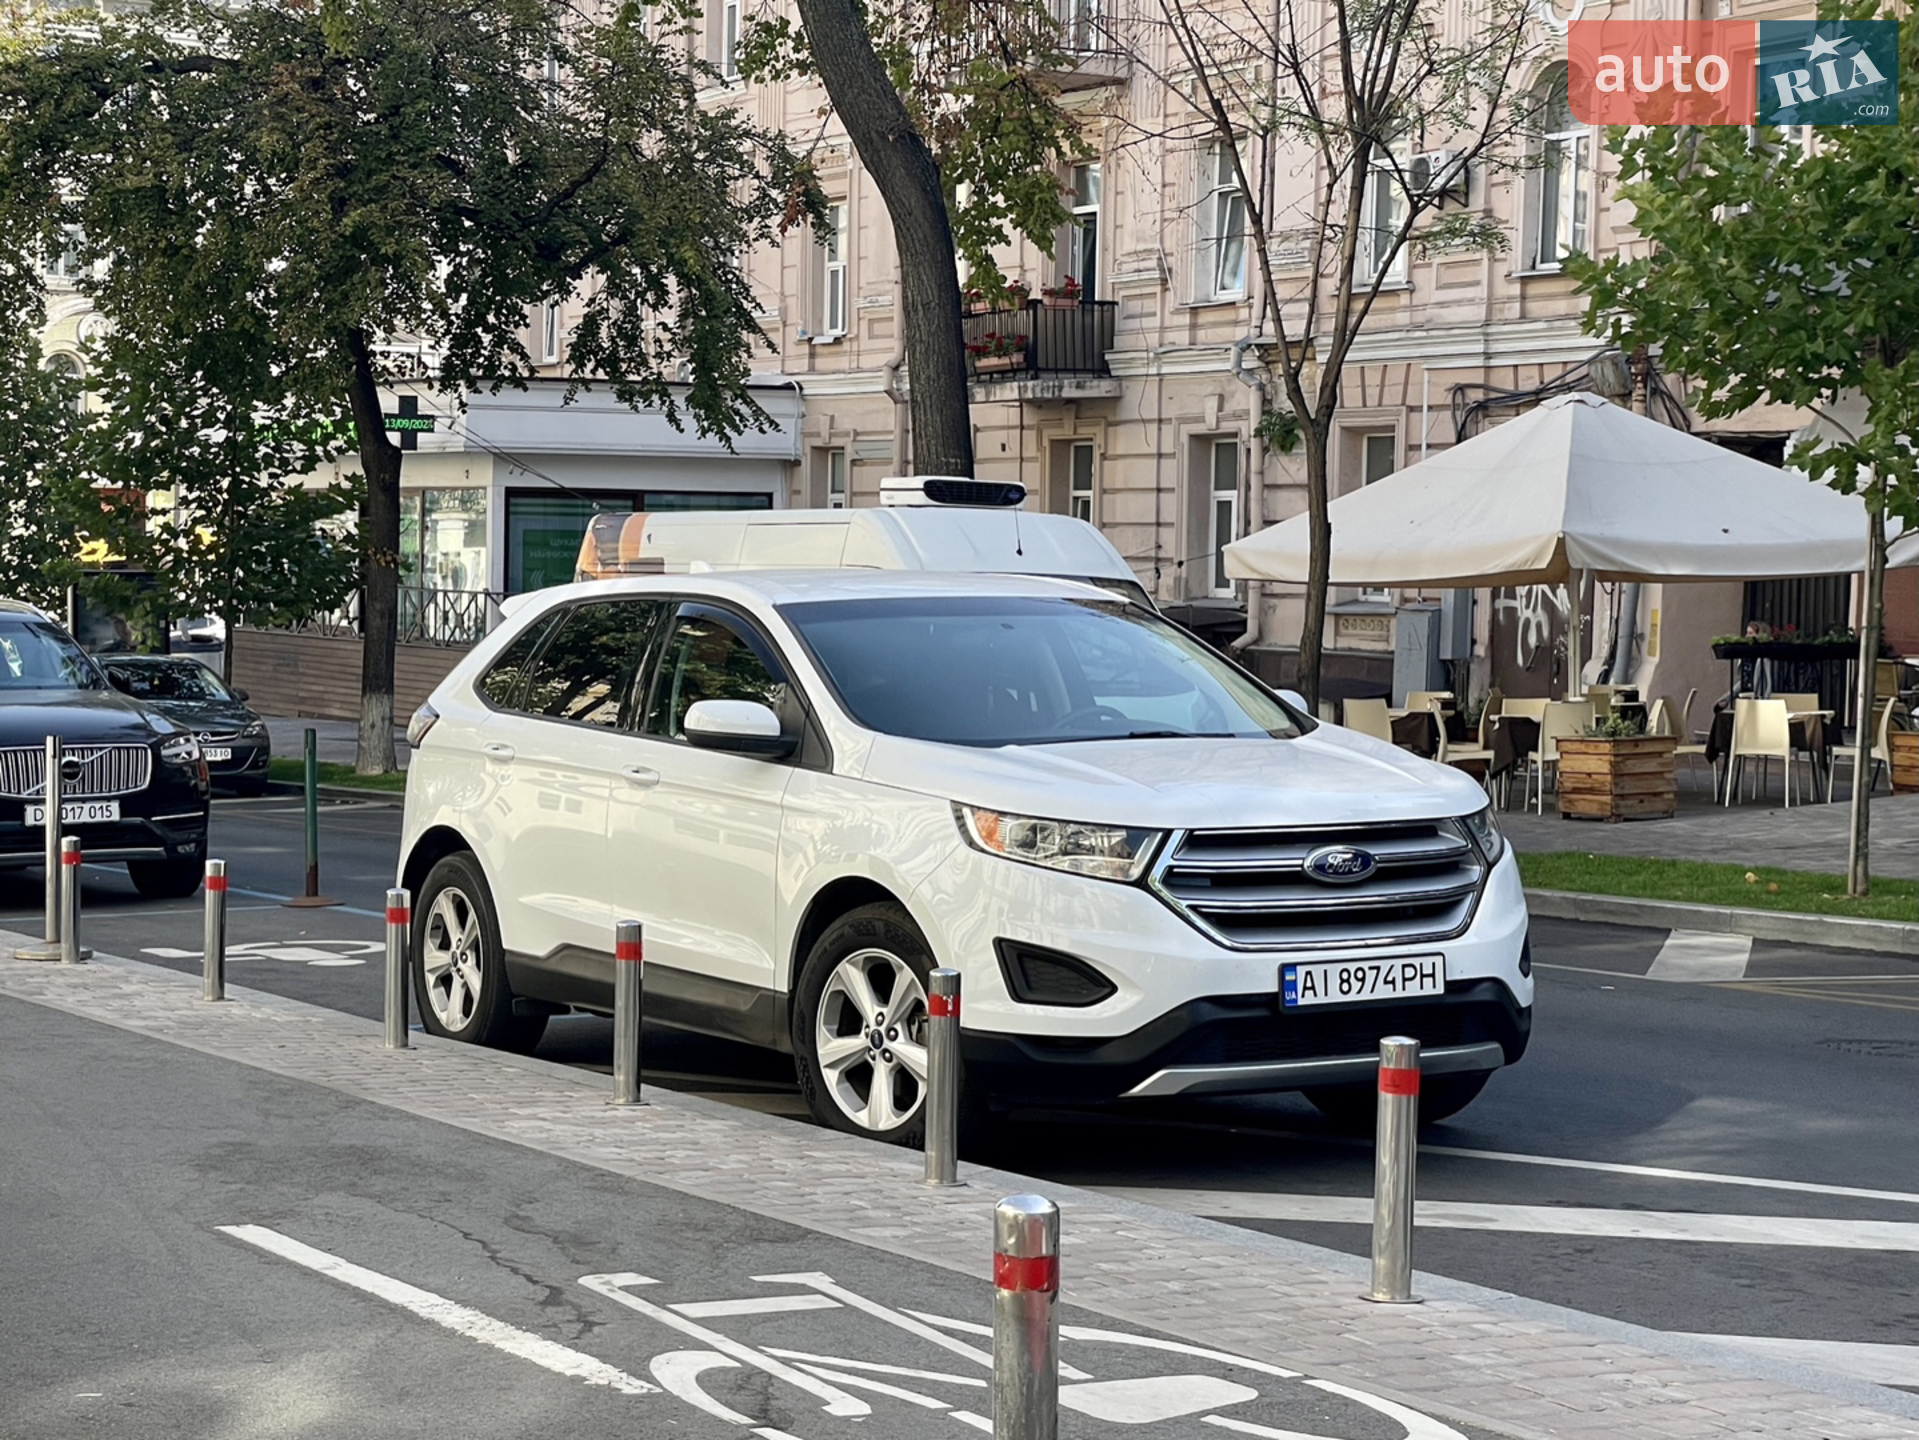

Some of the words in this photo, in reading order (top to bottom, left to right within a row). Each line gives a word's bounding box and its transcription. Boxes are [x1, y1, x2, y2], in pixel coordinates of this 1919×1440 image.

[61, 805, 84, 821] 017
[88, 804, 113, 820] 015
[1325, 853, 1363, 873] Ford
[1301, 969, 1328, 998] AI
[1338, 964, 1397, 995] 8974
[1401, 961, 1437, 991] PH
[1284, 990, 1297, 1000] UA
